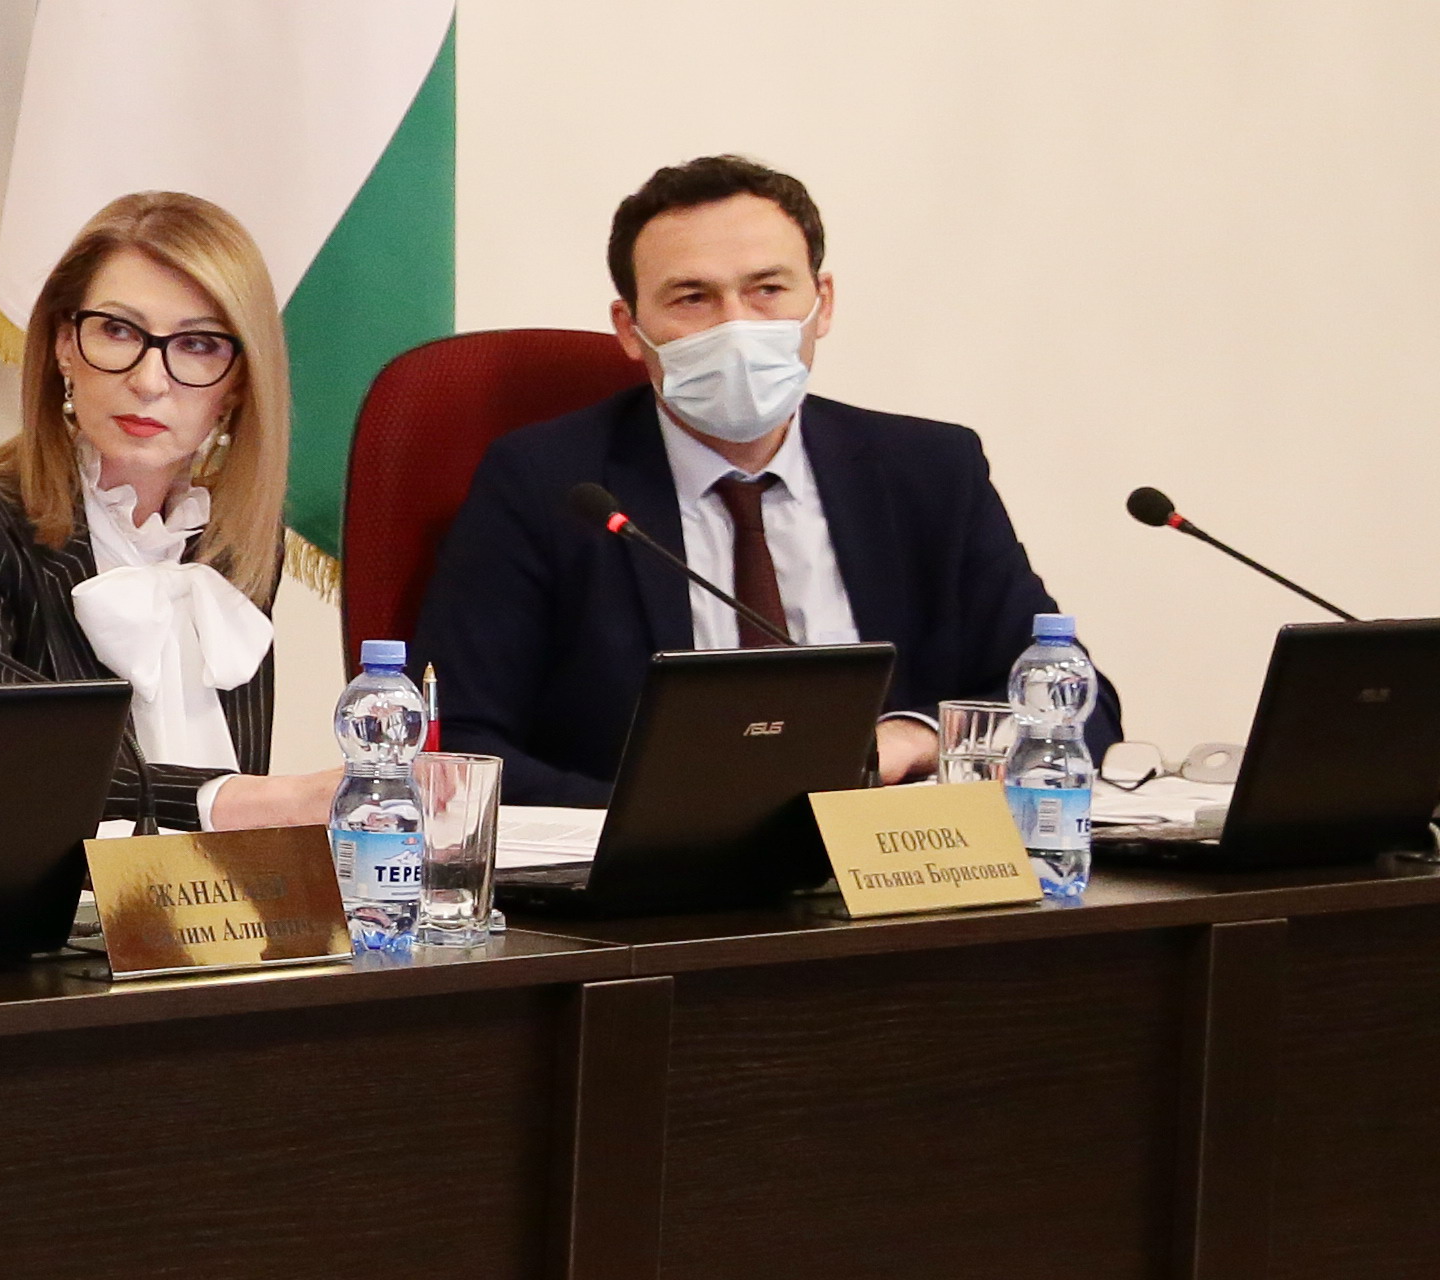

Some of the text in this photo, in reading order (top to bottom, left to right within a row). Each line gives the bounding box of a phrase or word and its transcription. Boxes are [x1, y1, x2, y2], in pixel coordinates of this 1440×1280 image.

[743, 721, 785, 736] ASUS
[875, 827, 970, 855] ЕГОРОВА
[848, 861, 1020, 891] Татьяна Борисовна
